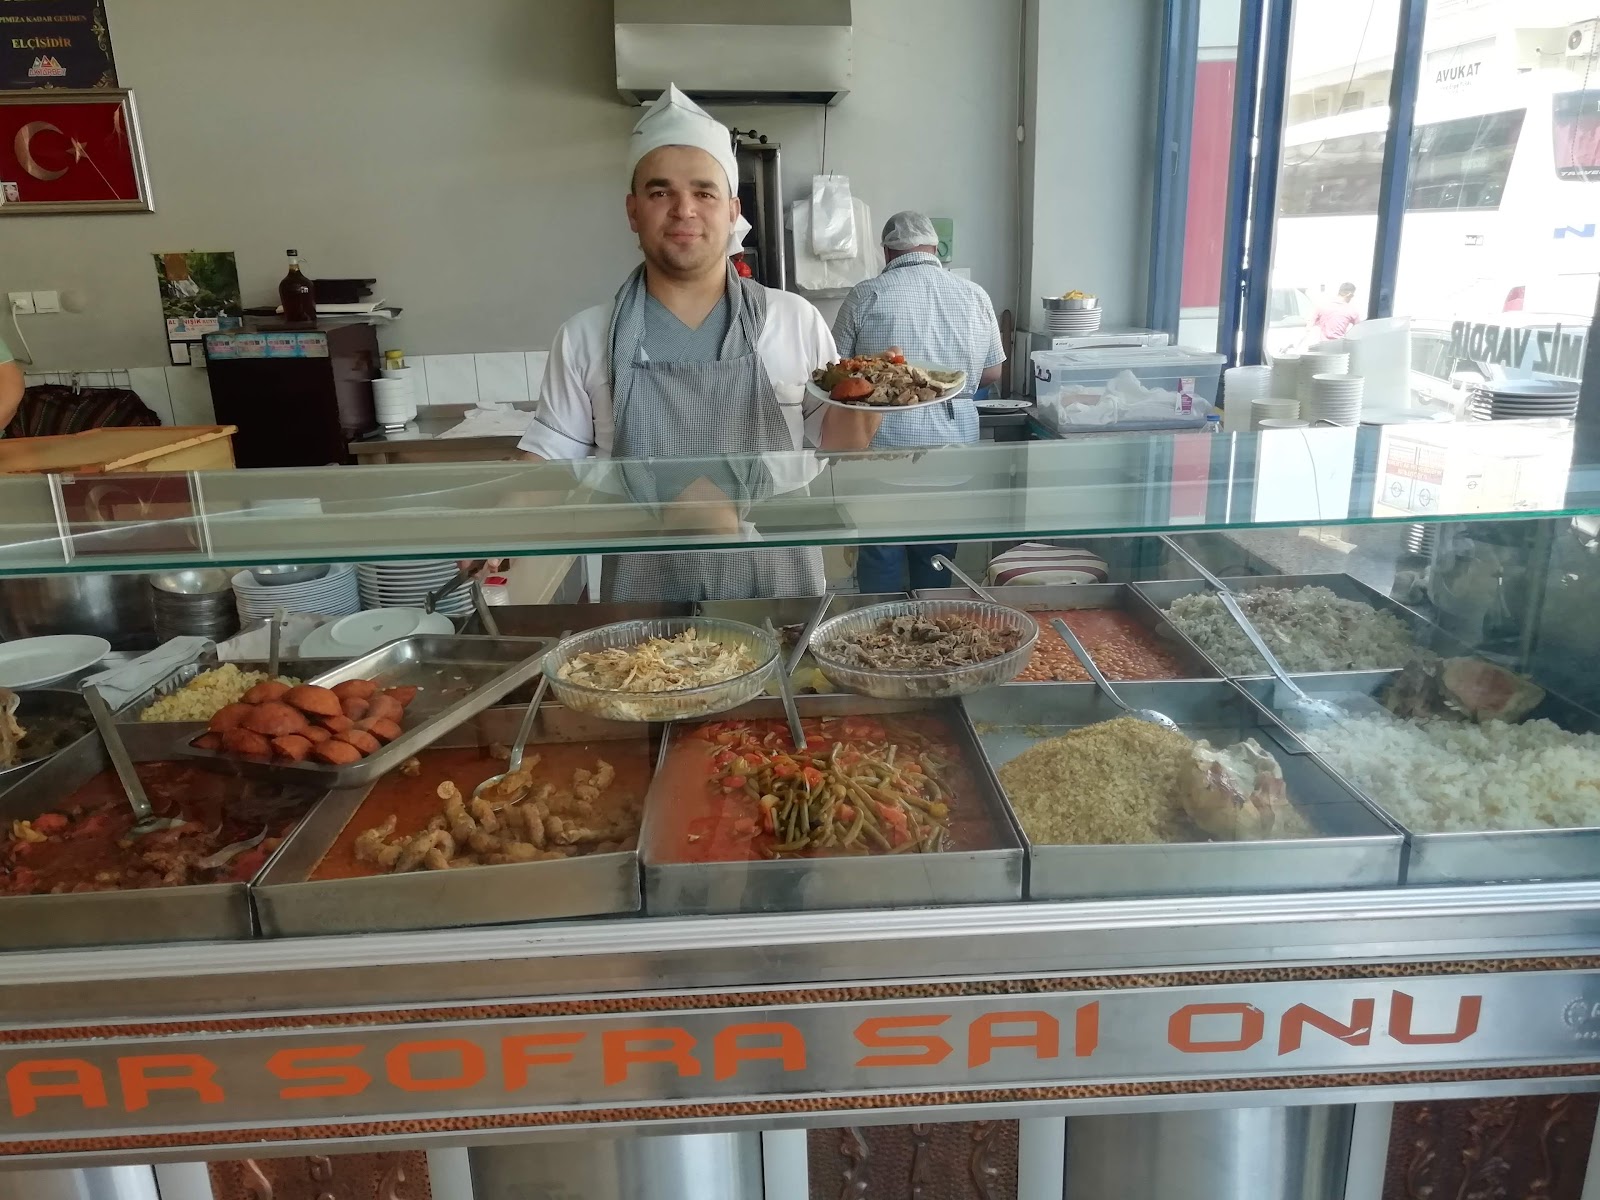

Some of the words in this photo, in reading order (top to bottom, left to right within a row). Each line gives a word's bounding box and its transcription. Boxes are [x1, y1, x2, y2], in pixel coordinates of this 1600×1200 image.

[12, 36, 72, 49] ELÇİSİDİR
[1435, 61, 1482, 84] AVUKAT
[5, 1058, 225, 1118] AR
[264, 1021, 807, 1100] SOFRA
